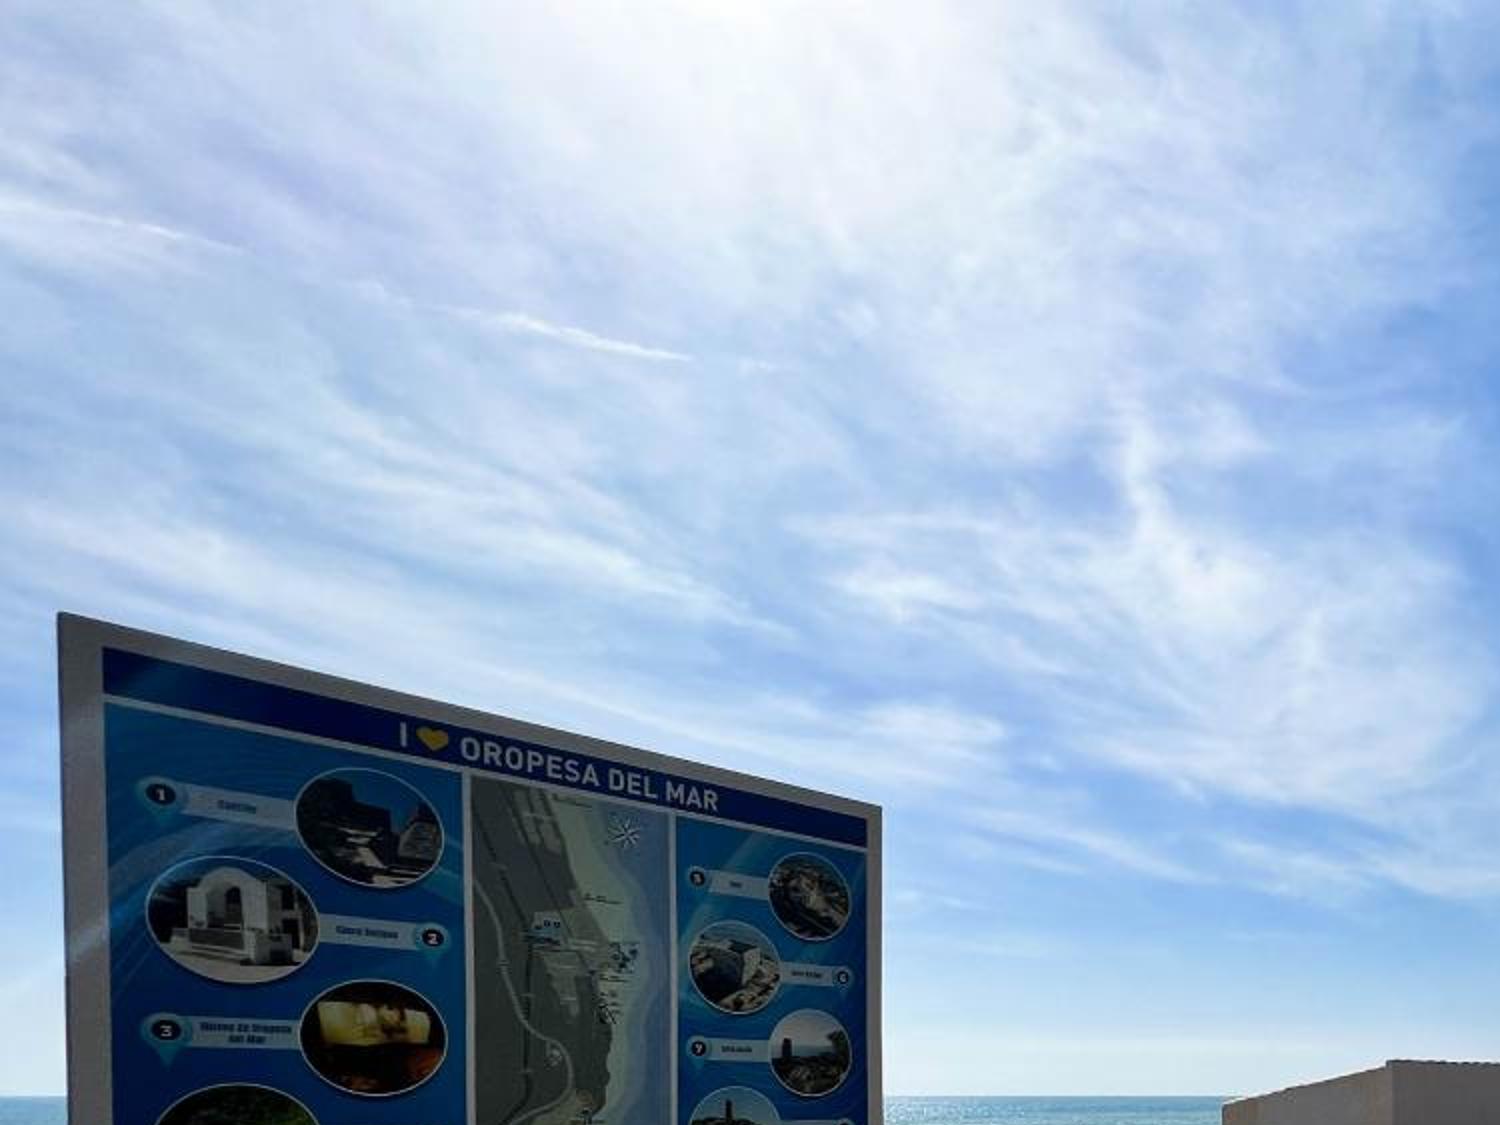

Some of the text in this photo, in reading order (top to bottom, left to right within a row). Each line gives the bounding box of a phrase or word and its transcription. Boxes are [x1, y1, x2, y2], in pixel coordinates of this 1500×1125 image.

[399, 722, 719, 813] I OROPESA DEL MAR
[155, 788, 166, 801] 1
[427, 932, 439, 945] 2
[159, 1024, 173, 1037] 3
